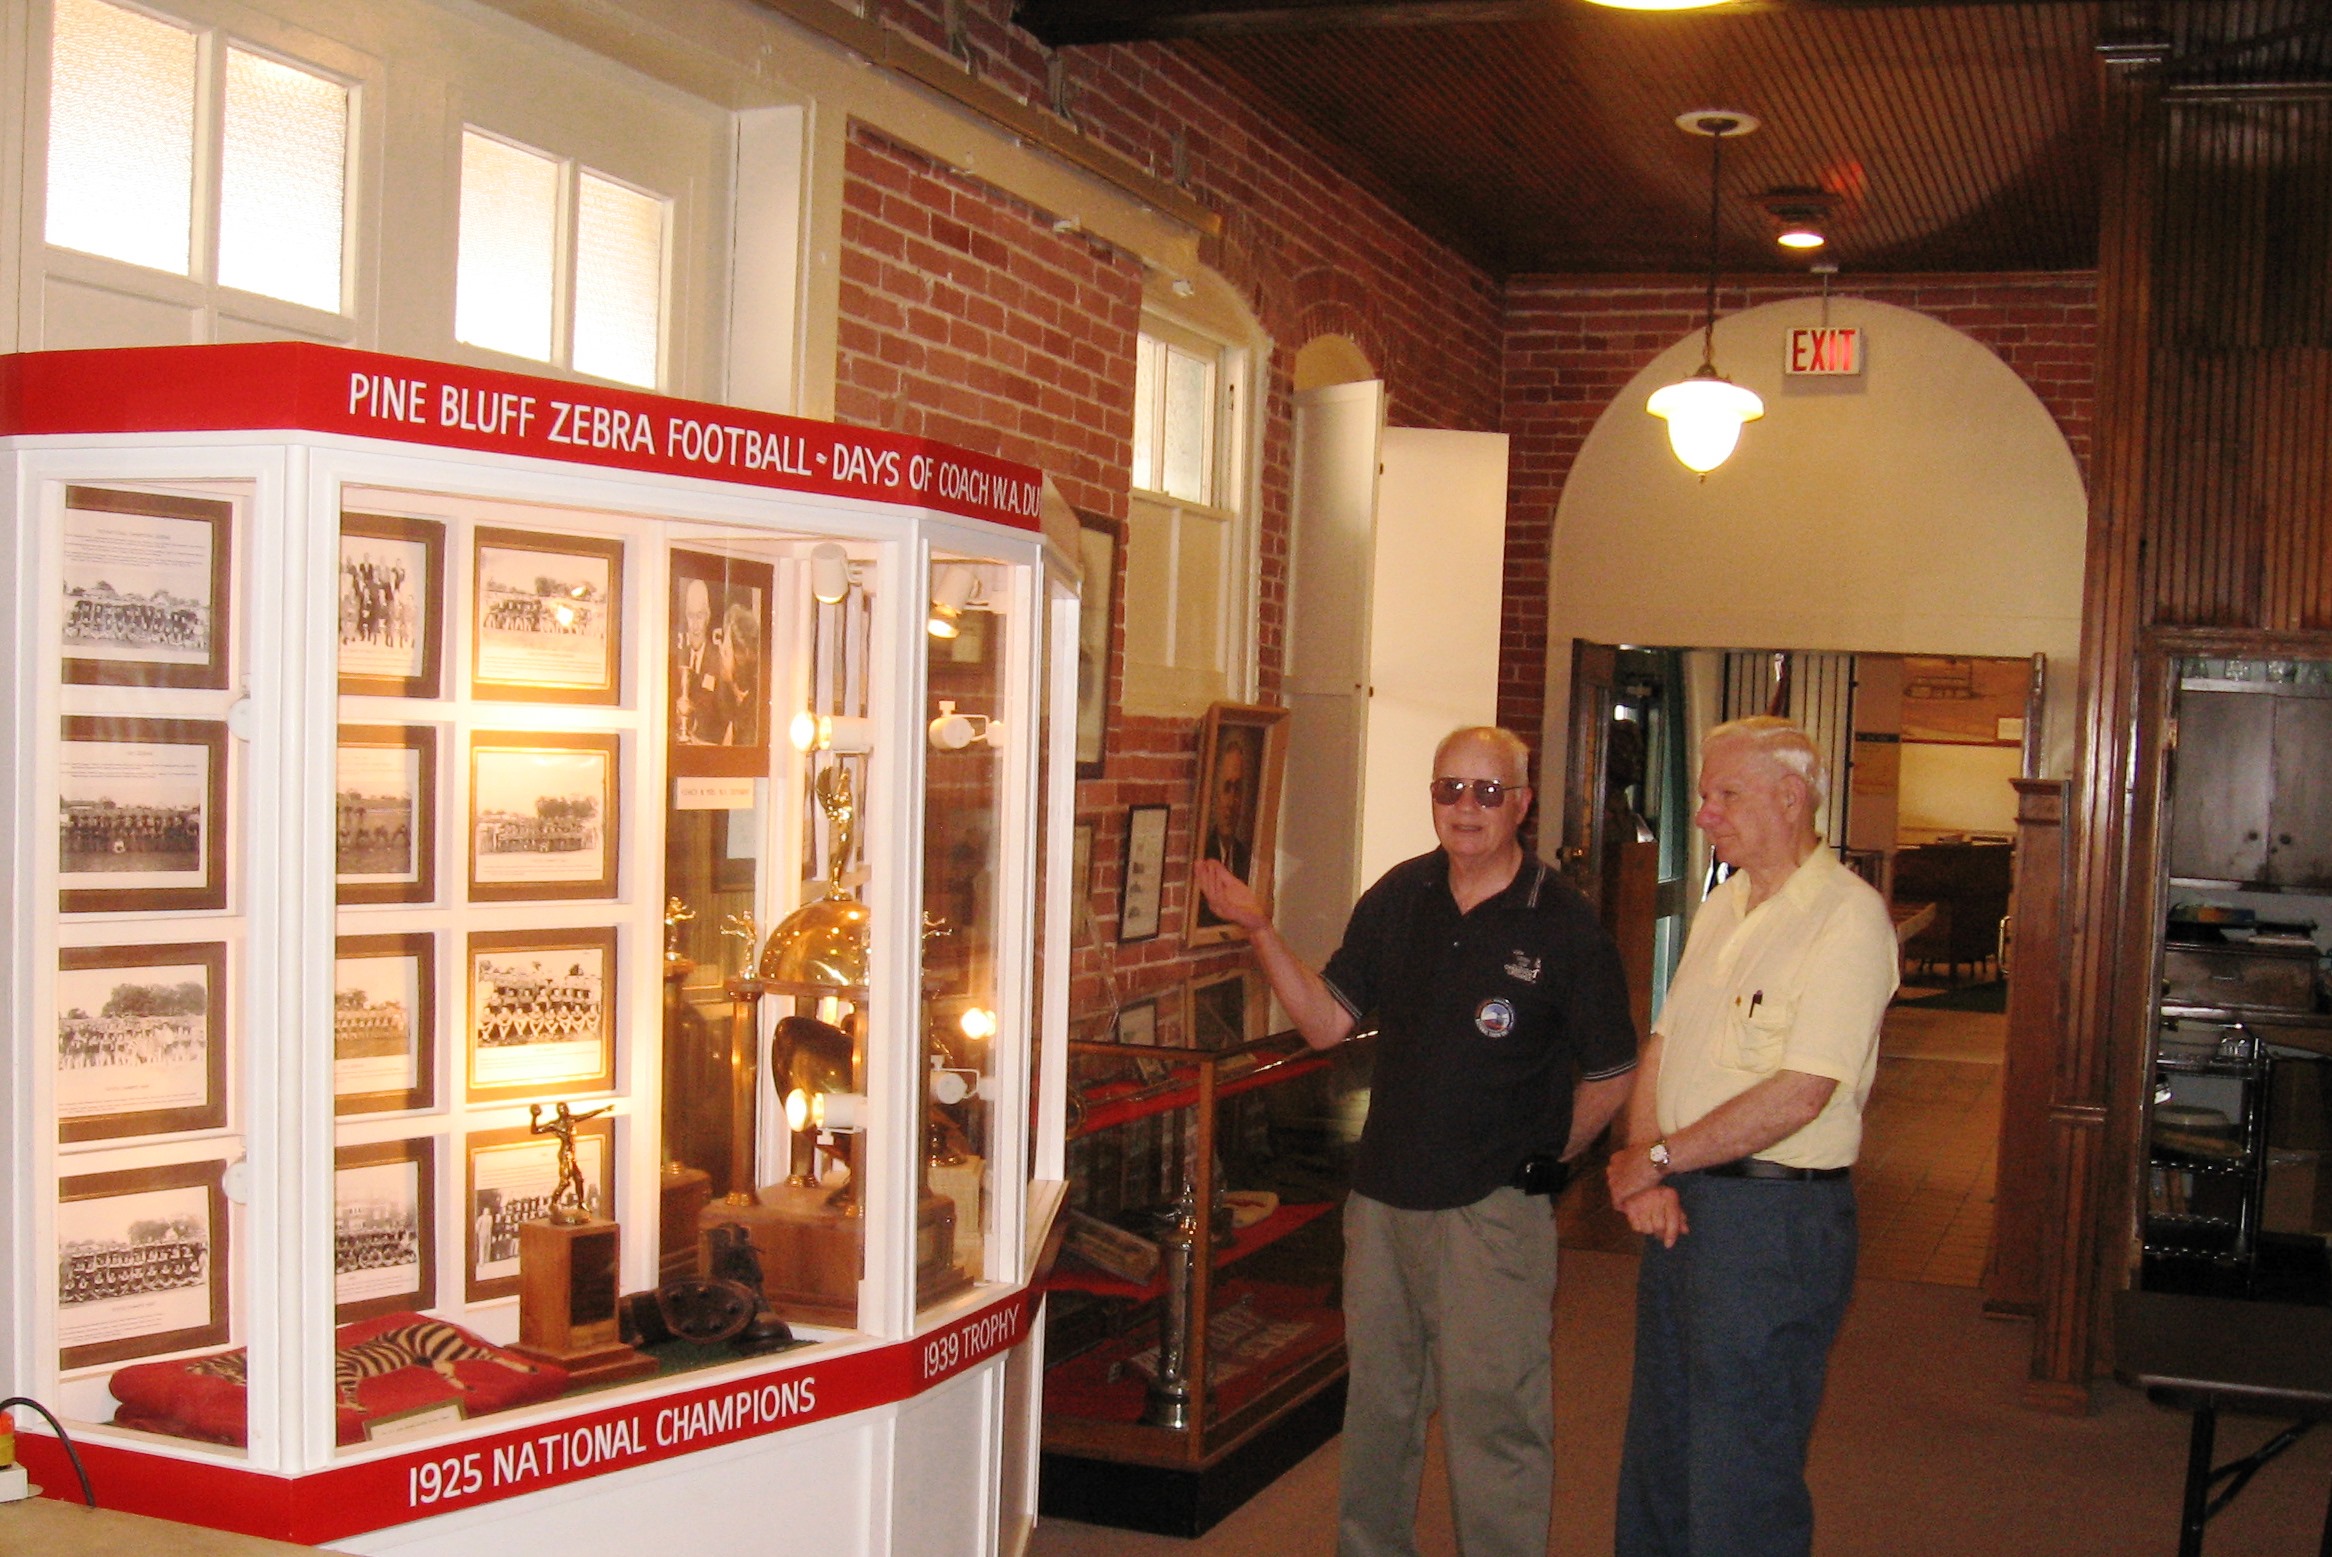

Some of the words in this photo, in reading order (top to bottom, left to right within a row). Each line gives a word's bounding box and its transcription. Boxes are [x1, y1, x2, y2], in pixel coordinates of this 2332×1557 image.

[1792, 329, 1855, 371] EXIT
[349, 372, 427, 424] PINE
[440, 385, 536, 438] BLUFF
[547, 401, 656, 455] ZEBRA
[667, 417, 813, 477] FOOTBALL
[832, 442, 901, 488] DAYS
[908, 454, 934, 492] OF
[938, 461, 990, 507] COACH
[924, 1332, 959, 1379] 1939
[962, 1303, 1020, 1359] TROPHY
[409, 1452, 483, 1507] 1925
[493, 1416, 647, 1488] NATIONAL
[655, 1376, 817, 1447] CHAMPIONS
